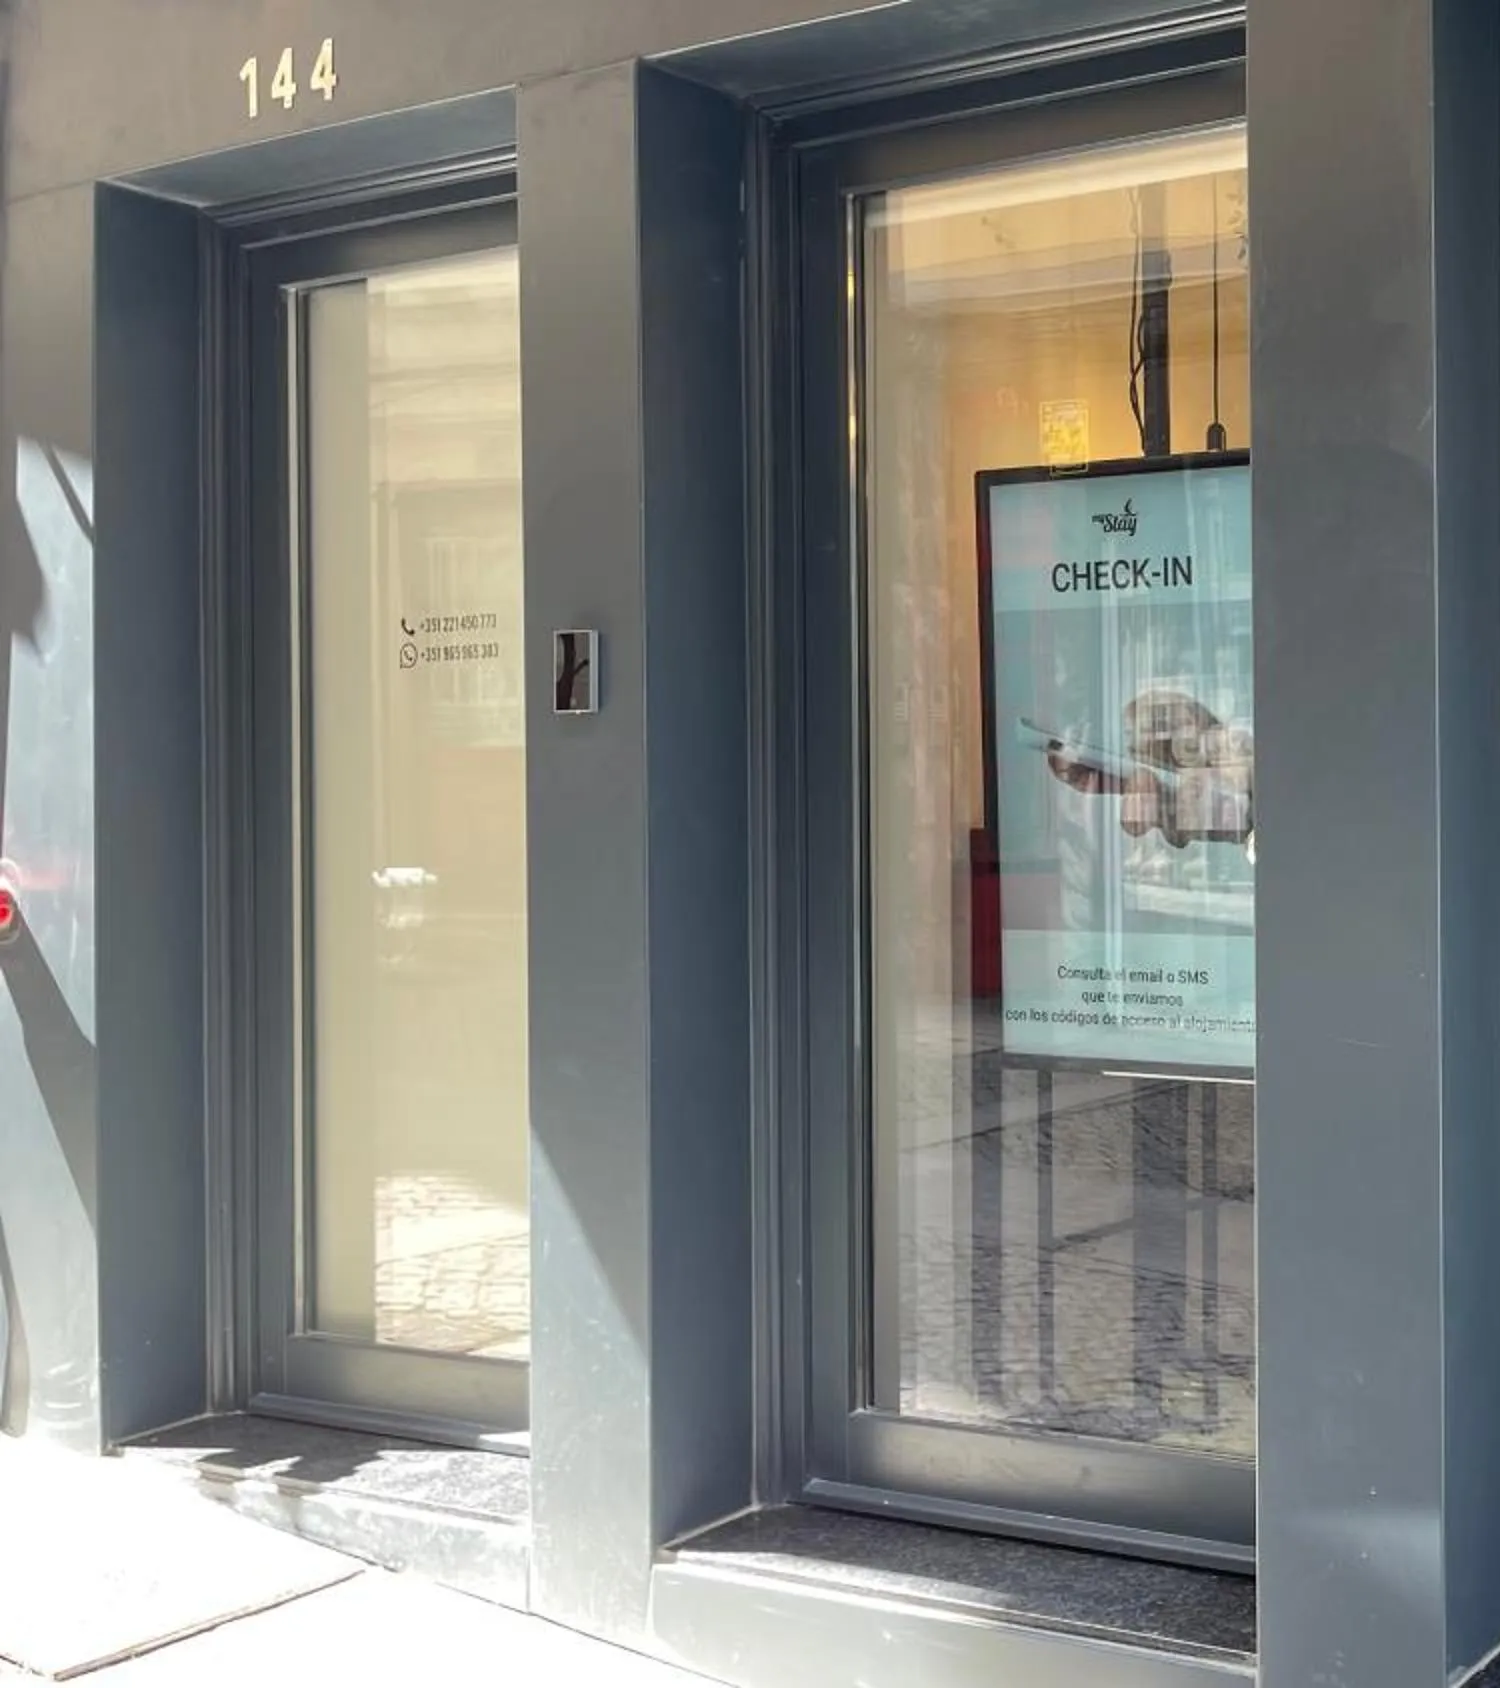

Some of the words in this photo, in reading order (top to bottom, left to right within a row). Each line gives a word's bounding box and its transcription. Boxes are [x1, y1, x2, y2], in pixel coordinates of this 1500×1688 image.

[239, 37, 337, 118] 144
[1052, 556, 1193, 592] CHECK-IN
[1129, 968, 1163, 983] email
[1177, 969, 1209, 985] SMS
[1081, 991, 1105, 1005] que
[1123, 992, 1184, 1007] enviamos
[1005, 1009, 1027, 1021] con
[1029, 1008, 1049, 1022] los
[1051, 1009, 1099, 1027] códigos
[1102, 1013, 1118, 1025] de
